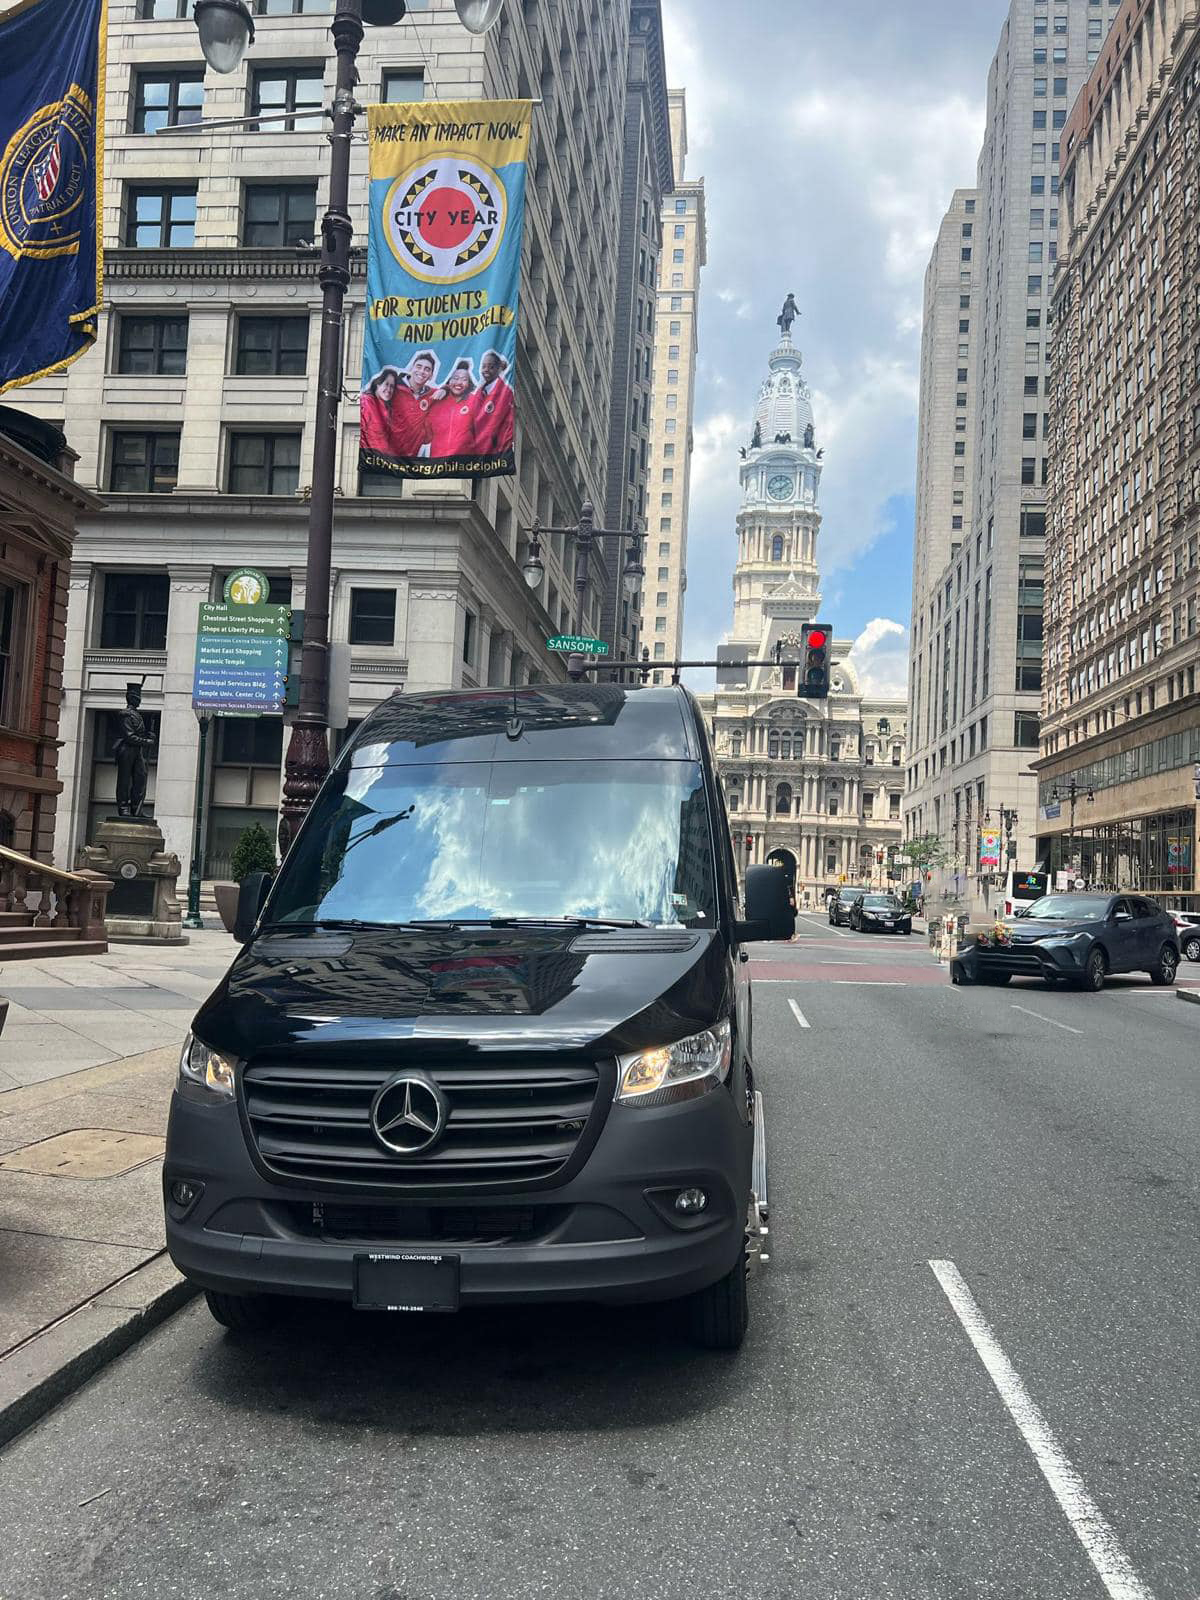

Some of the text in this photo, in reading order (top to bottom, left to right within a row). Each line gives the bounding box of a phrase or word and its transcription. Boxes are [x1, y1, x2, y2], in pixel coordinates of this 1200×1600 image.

[374, 120, 523, 142] MAKE AN IMPACT NOW.
[65, 160, 81, 197] DUCIT
[8, 176, 20, 224] UNION
[394, 210, 498, 227] CITY YEAR
[375, 290, 483, 318] FOR STUDENTS
[403, 323, 434, 343] AND
[203, 604, 215, 612] City
[247, 616, 274, 624] Shopping
[202, 625, 220, 633] Shops
[235, 648, 262, 656] Shopping
[549, 639, 593, 652] SANSOM
[224, 658, 245, 666] Temple
[254, 691, 266, 699] City
